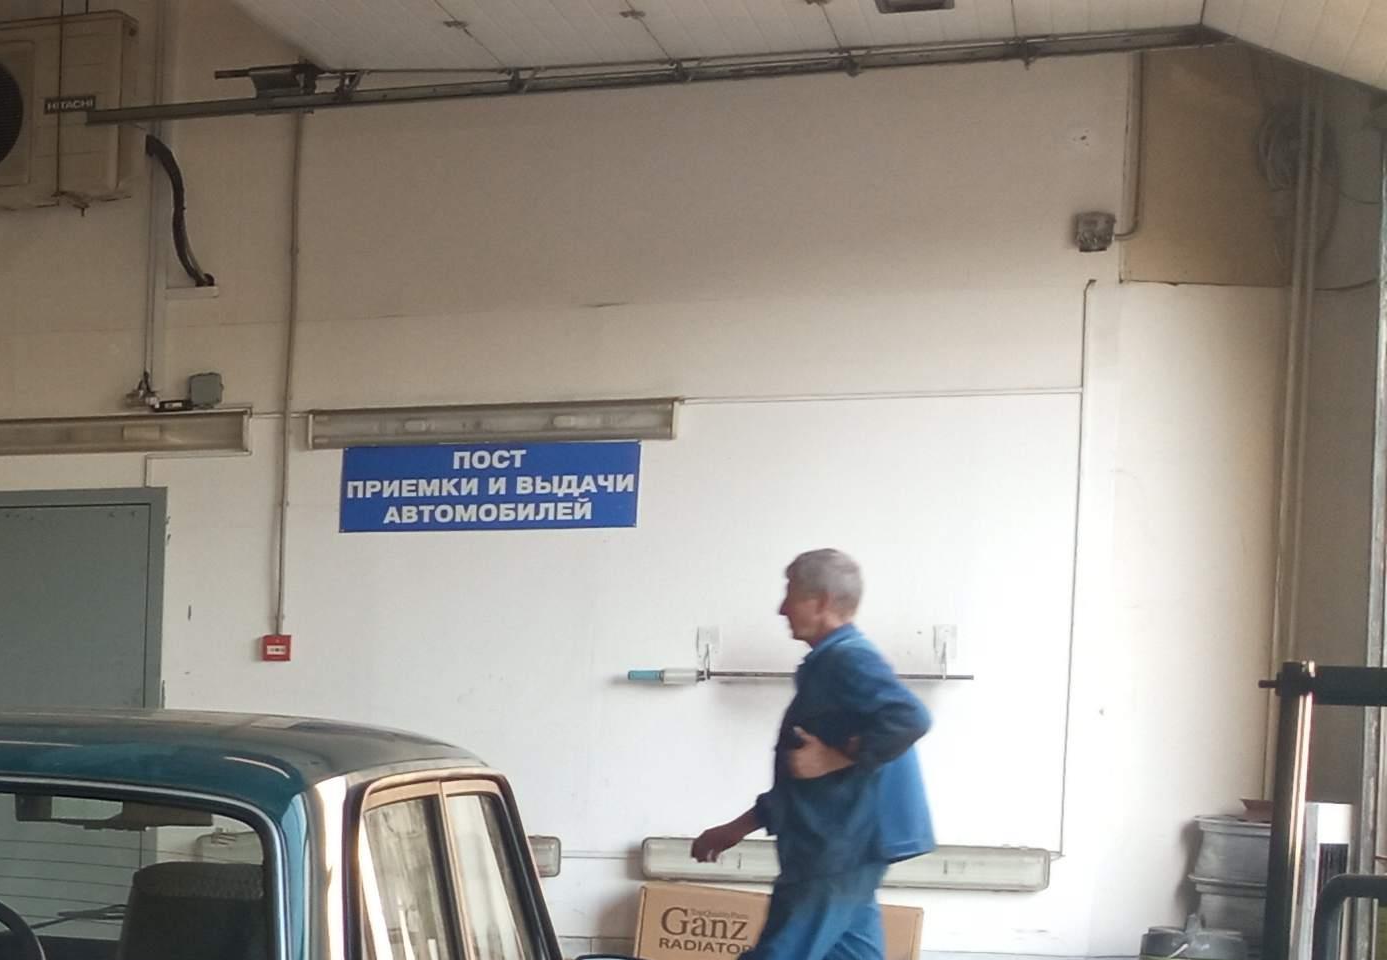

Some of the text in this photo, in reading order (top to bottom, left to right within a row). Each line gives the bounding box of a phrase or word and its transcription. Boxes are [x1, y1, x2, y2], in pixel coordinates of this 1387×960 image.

[46, 98, 94, 111] HITACHI
[452, 449, 527, 470] ПОСТ
[346, 473, 635, 499] ПРИЕМКИ И ВЫДАЧИ
[383, 498, 593, 524] АВТОМОБИЛЕЙ
[660, 906, 749, 941] Ganz
